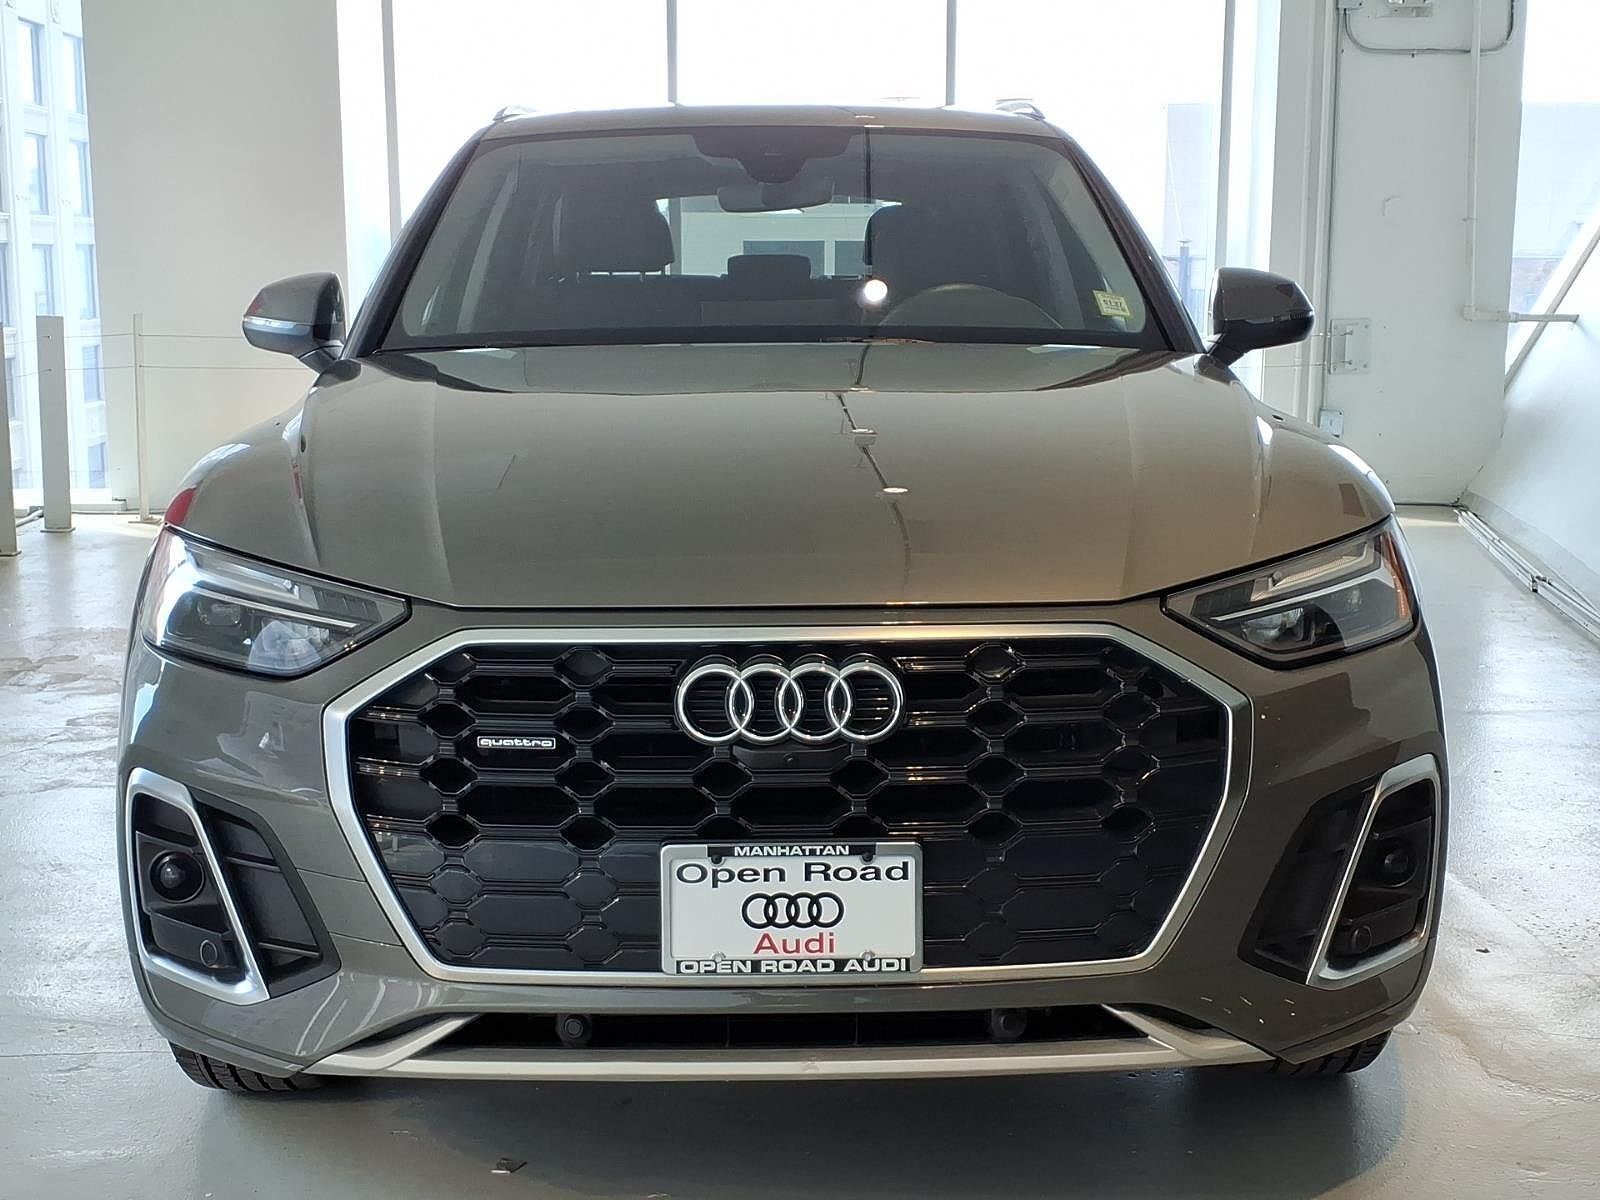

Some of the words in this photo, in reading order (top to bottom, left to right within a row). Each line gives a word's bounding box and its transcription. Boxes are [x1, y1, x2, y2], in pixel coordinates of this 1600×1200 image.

[480, 738, 552, 747] quattro
[734, 845, 849, 857] MANHATTAN
[676, 863, 786, 888] Open
[804, 861, 909, 882] Road
[753, 932, 835, 954] Audi
[680, 960, 751, 974] OPEN
[761, 959, 836, 973] ROAD
[843, 958, 906, 972] AUDI
